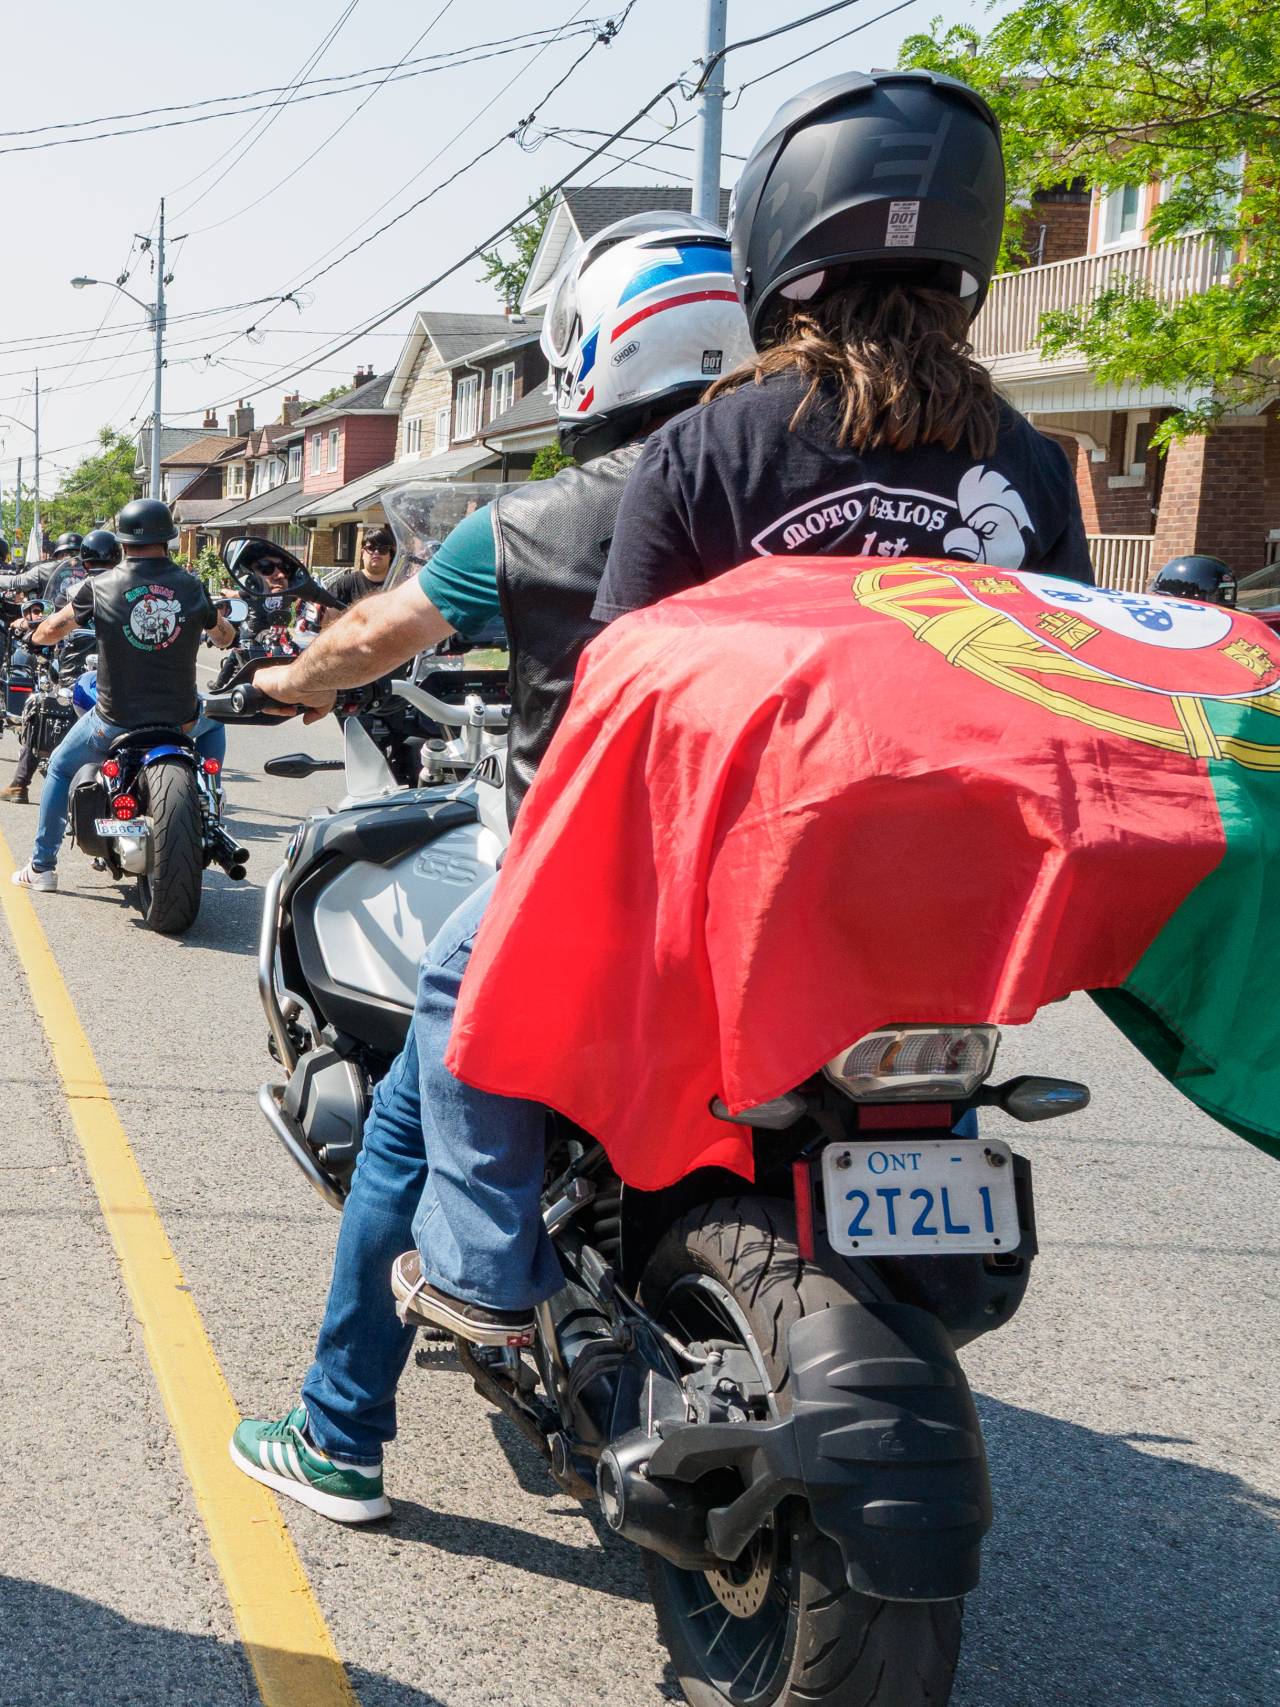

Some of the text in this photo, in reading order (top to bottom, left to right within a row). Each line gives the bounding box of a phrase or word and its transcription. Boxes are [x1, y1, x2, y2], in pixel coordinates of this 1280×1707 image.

[889, 212, 917, 225] DOT
[613, 343, 637, 365] SHOEI
[703, 357, 721, 368] DOT
[782, 499, 863, 550] MOTO
[845, 1186, 995, 1237] 2T2L1
